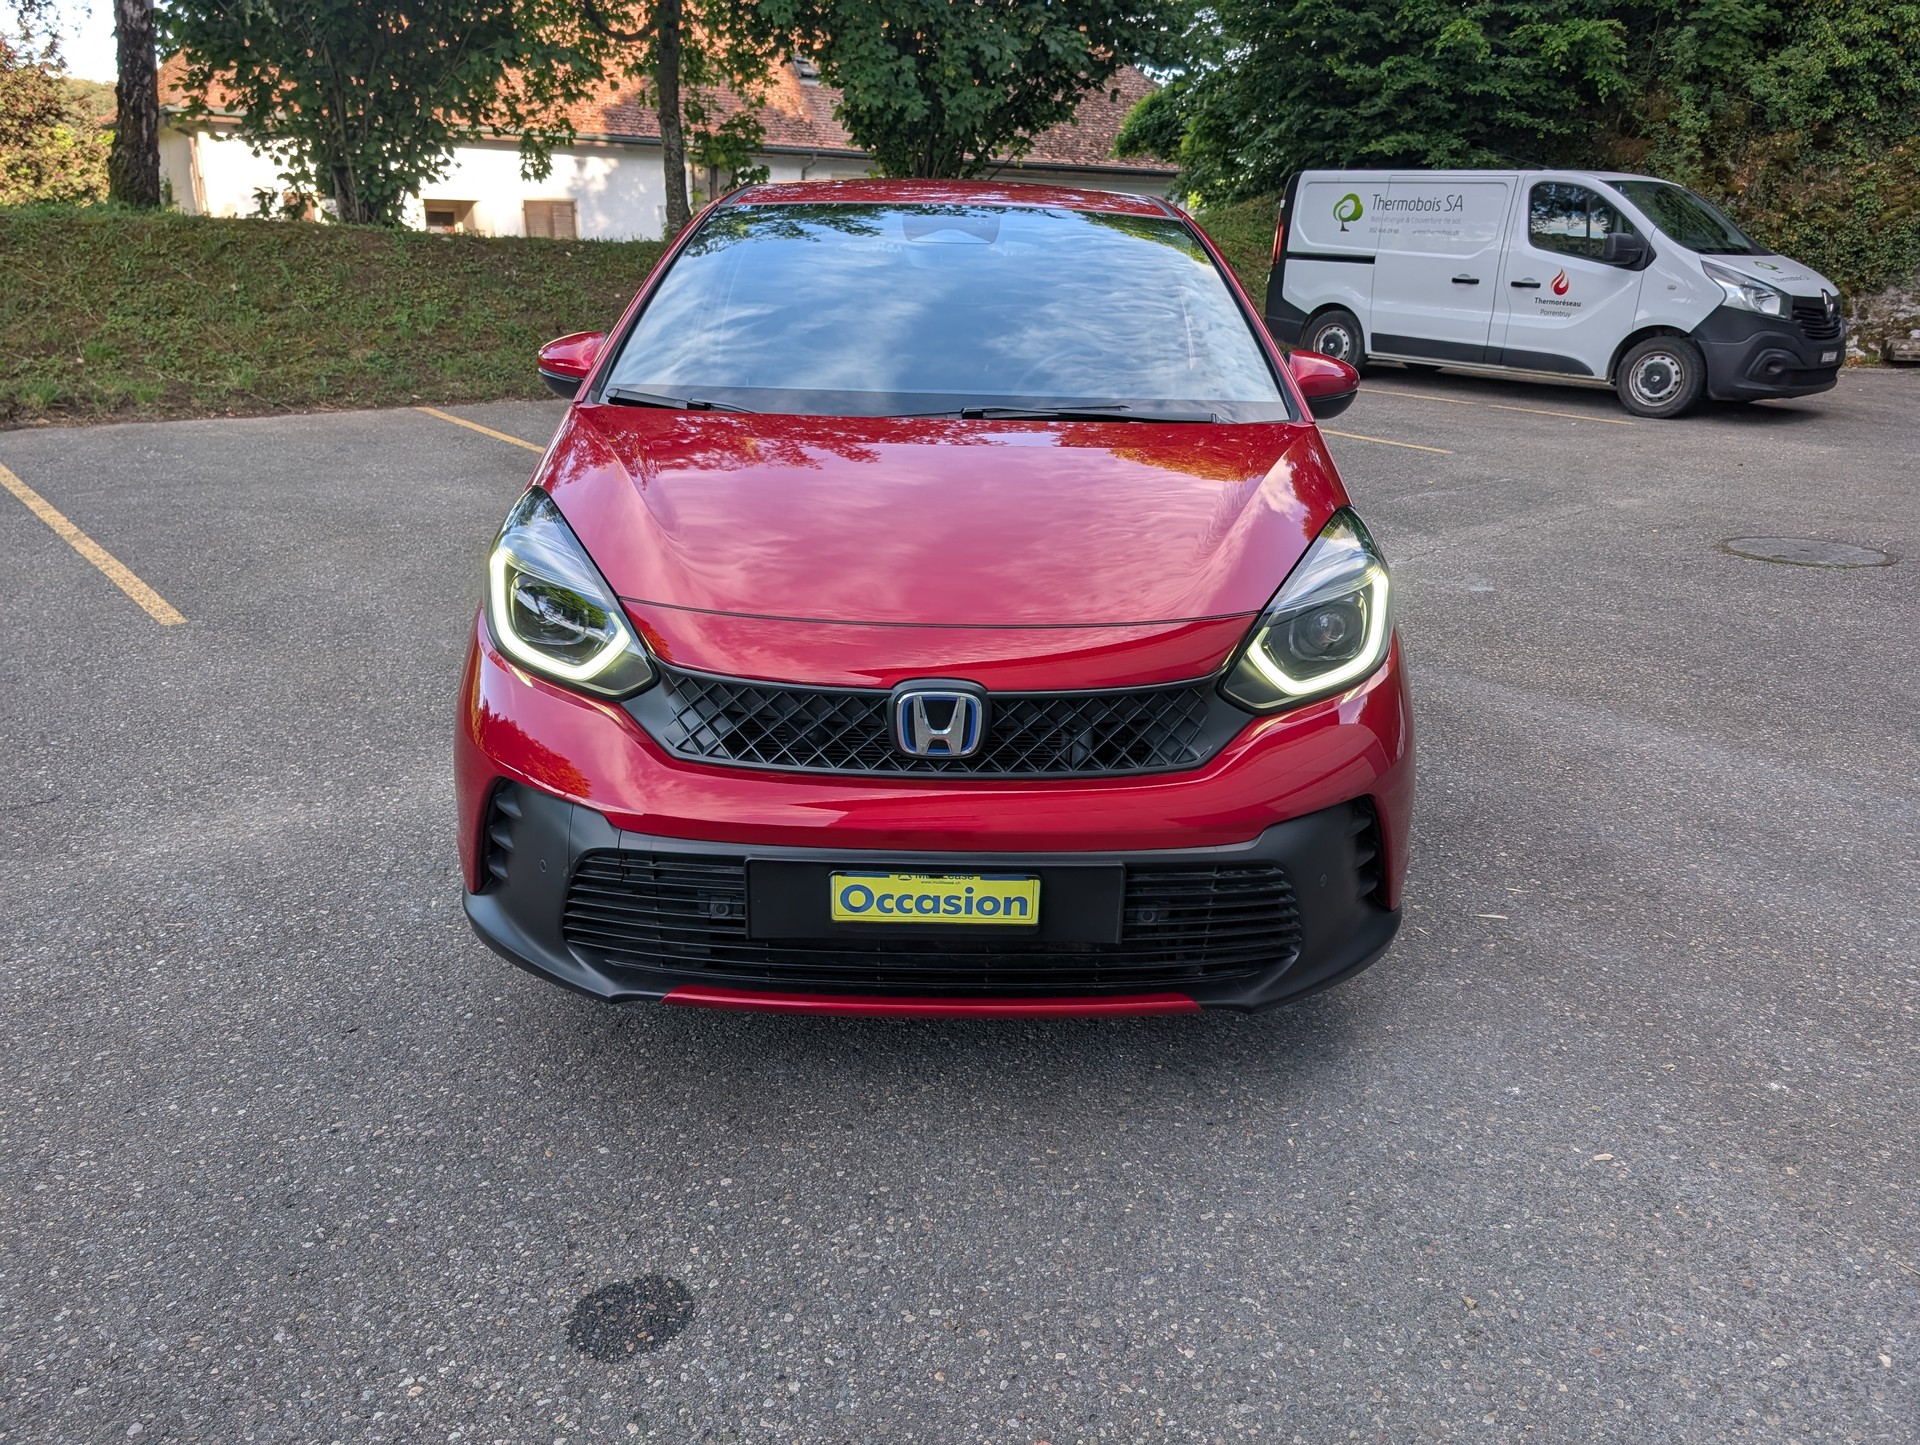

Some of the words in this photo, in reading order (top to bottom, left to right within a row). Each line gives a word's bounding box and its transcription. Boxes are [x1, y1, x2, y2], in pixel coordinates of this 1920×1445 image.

[1372, 194, 1442, 211] Thermobois
[1444, 194, 1463, 212] SA
[1534, 297, 1582, 307] Thermoréseau
[1540, 309, 1571, 319] Porrentruy
[839, 884, 1028, 916] Occasion
